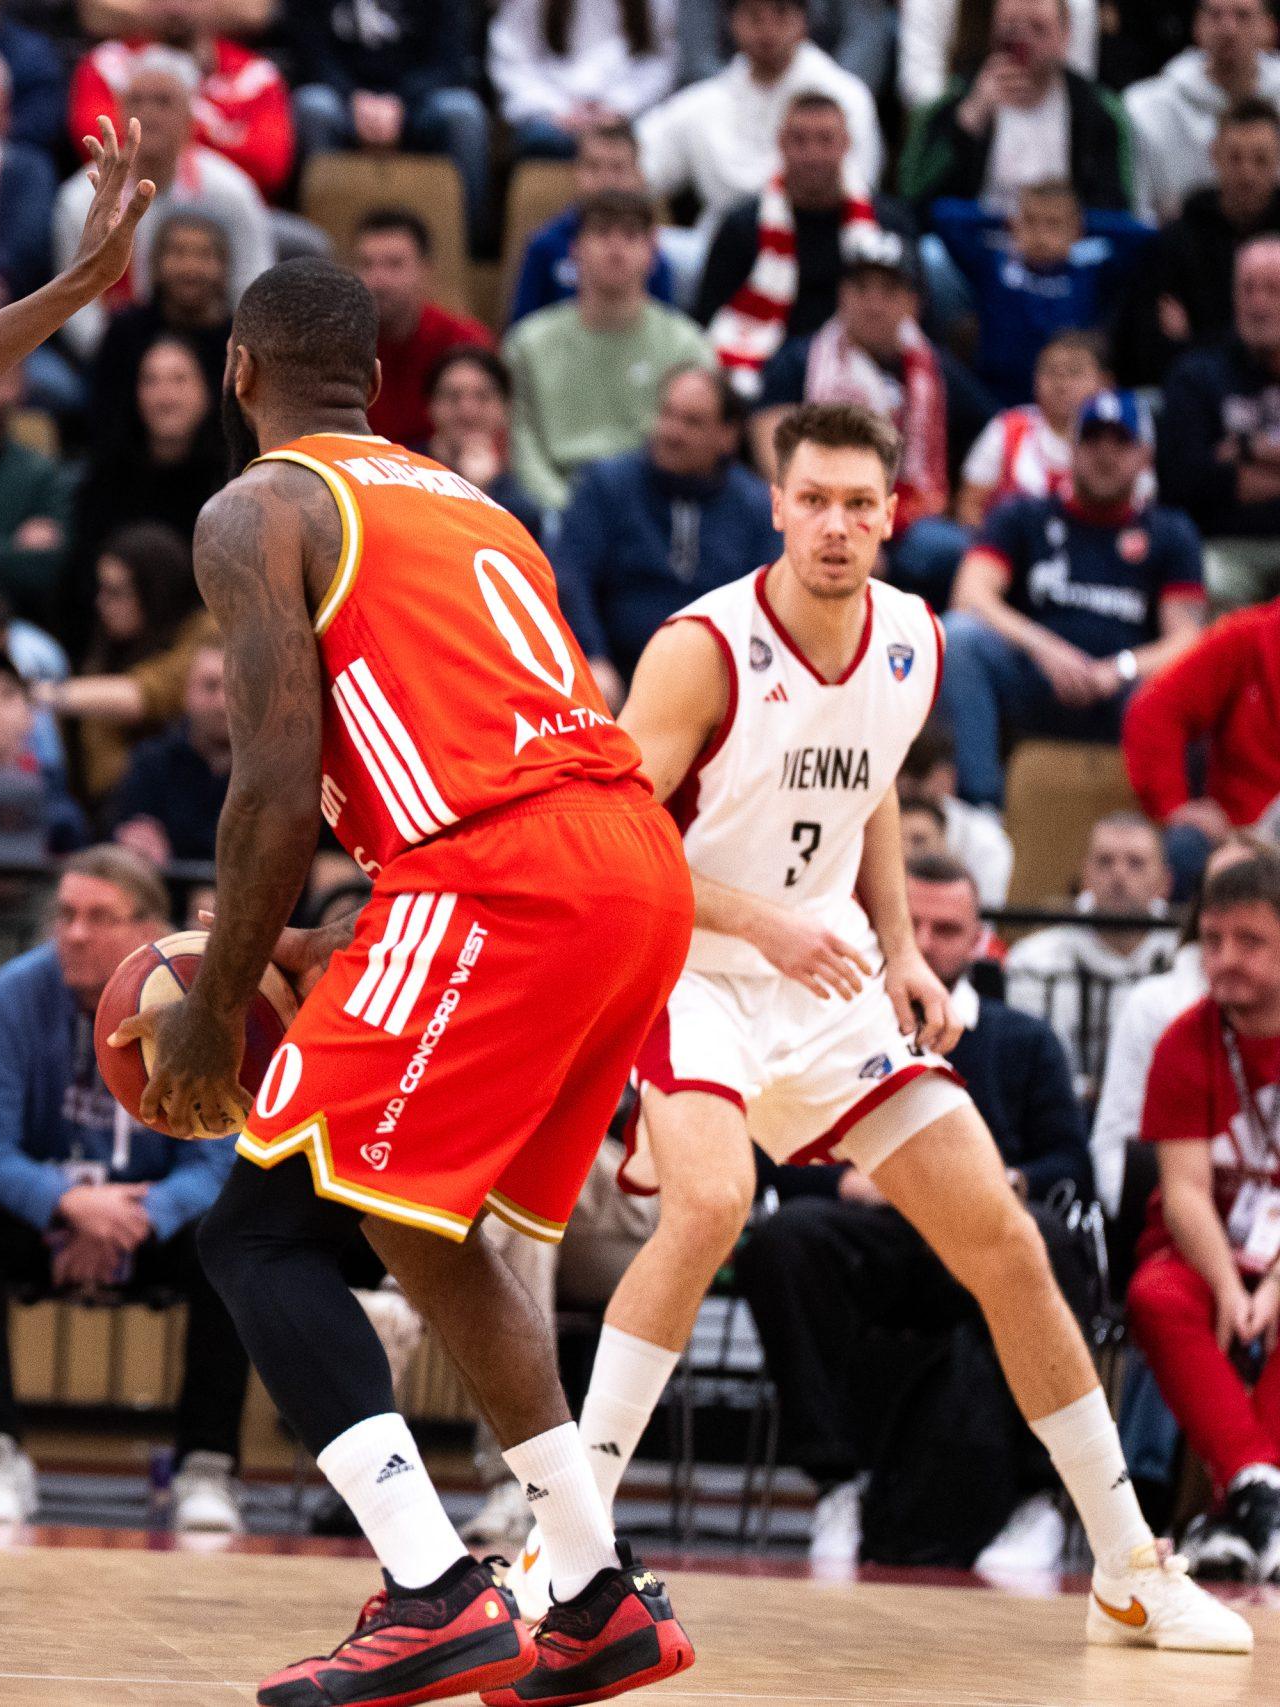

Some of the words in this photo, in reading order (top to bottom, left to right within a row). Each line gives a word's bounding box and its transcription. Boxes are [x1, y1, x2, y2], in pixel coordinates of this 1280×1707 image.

[473, 548, 575, 698] 0
[784, 821, 821, 888] 3
[255, 1042, 303, 1119] 0
[375, 1096, 408, 1134] W.D.
[399, 988, 460, 1094] CONCORD
[448, 921, 488, 985] WEST
